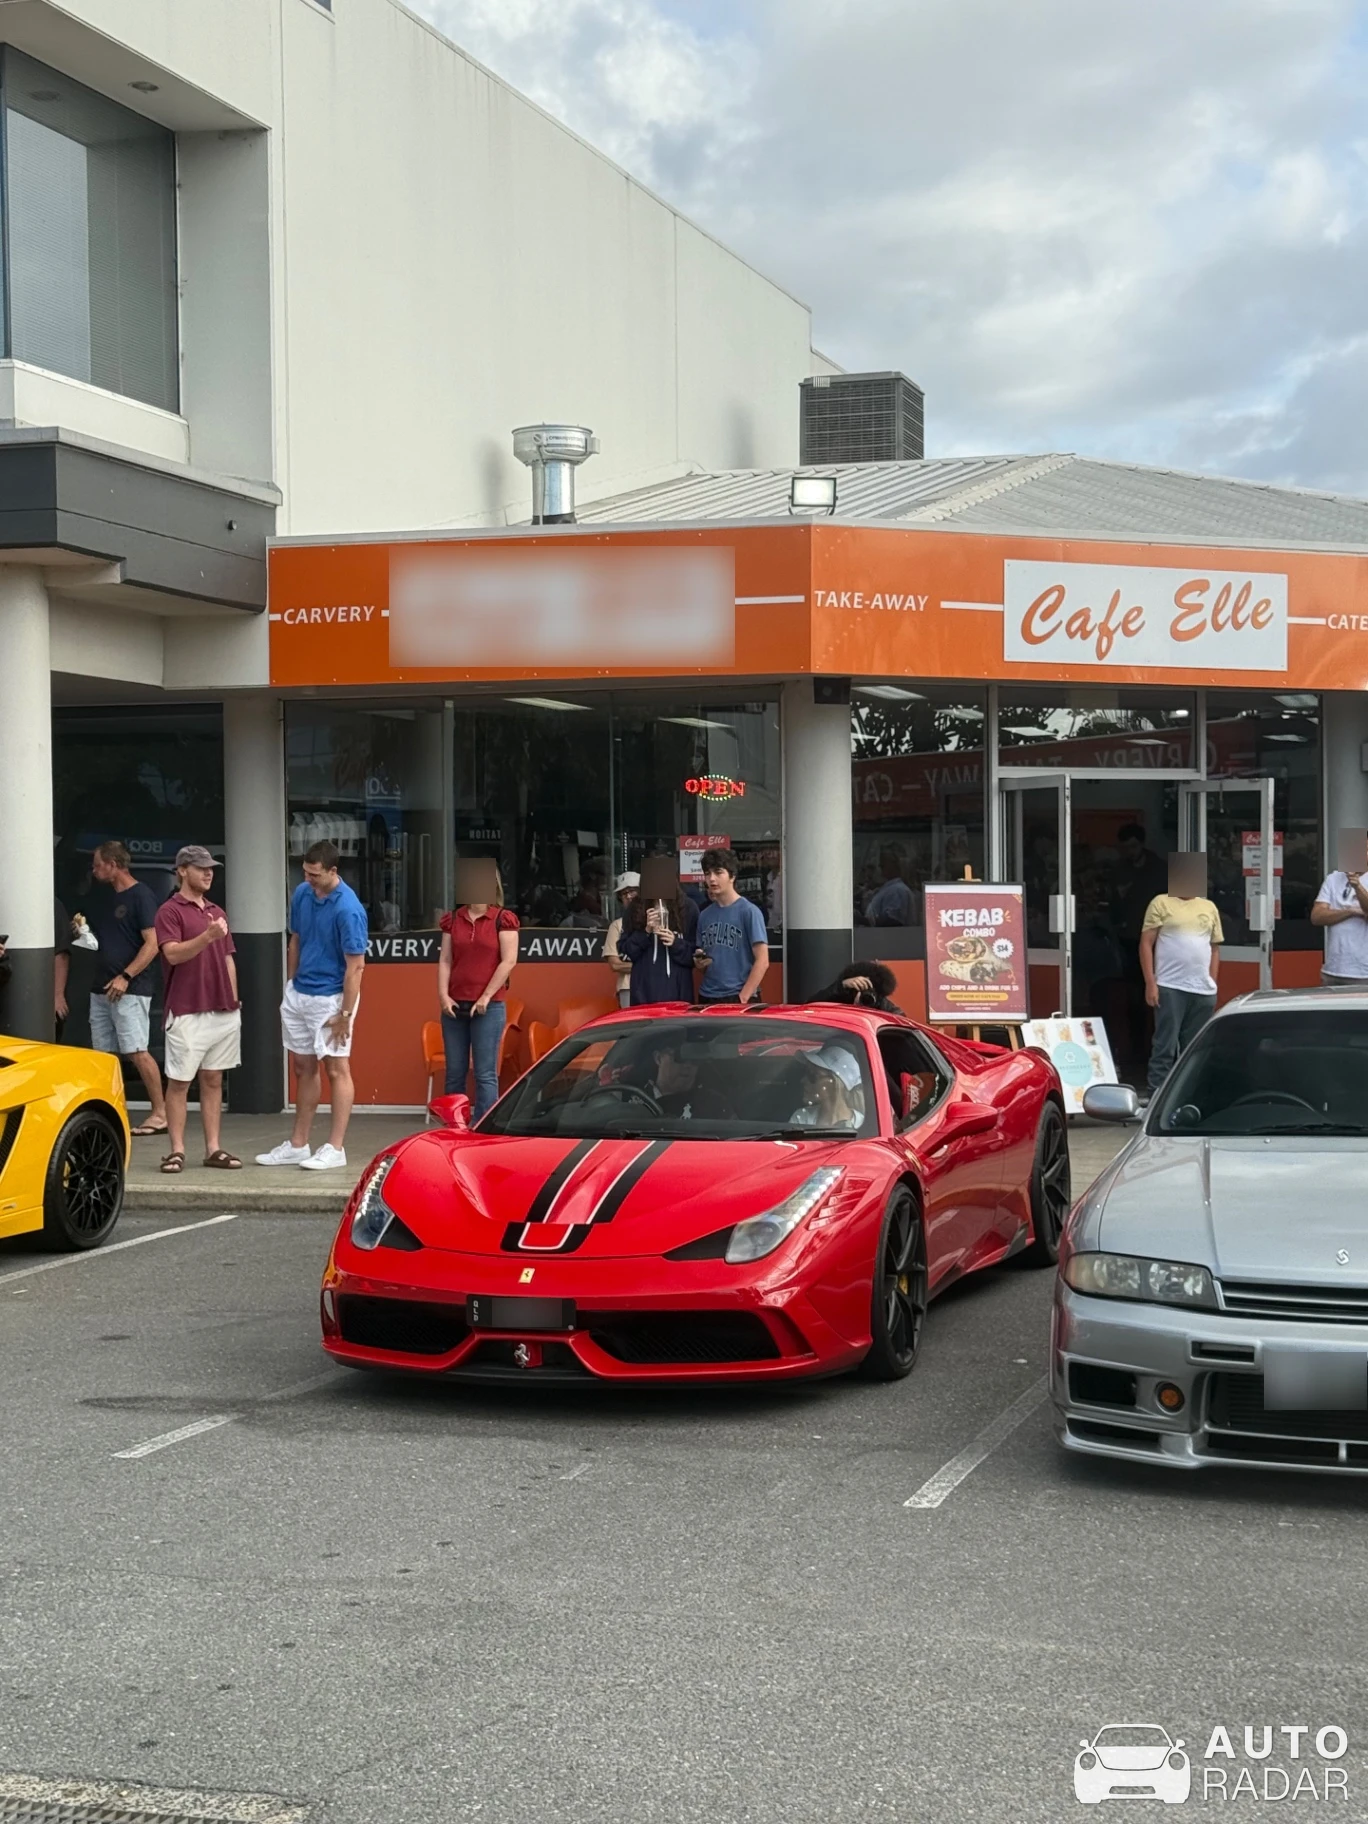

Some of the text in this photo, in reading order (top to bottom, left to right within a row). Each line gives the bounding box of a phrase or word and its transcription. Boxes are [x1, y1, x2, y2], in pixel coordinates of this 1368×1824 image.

[814, 590, 928, 612] TAKE-AWAY
[283, 605, 375, 625] CARVERY
[1021, 578, 1274, 661] Cafe Elle
[685, 779, 746, 797] OPEN
[685, 836, 726, 848] Cafe Elle
[941, 908, 1004, 927] KEBAB
[963, 928, 996, 937] COMBO
[367, 938, 598, 958] RVERY -AWAY
